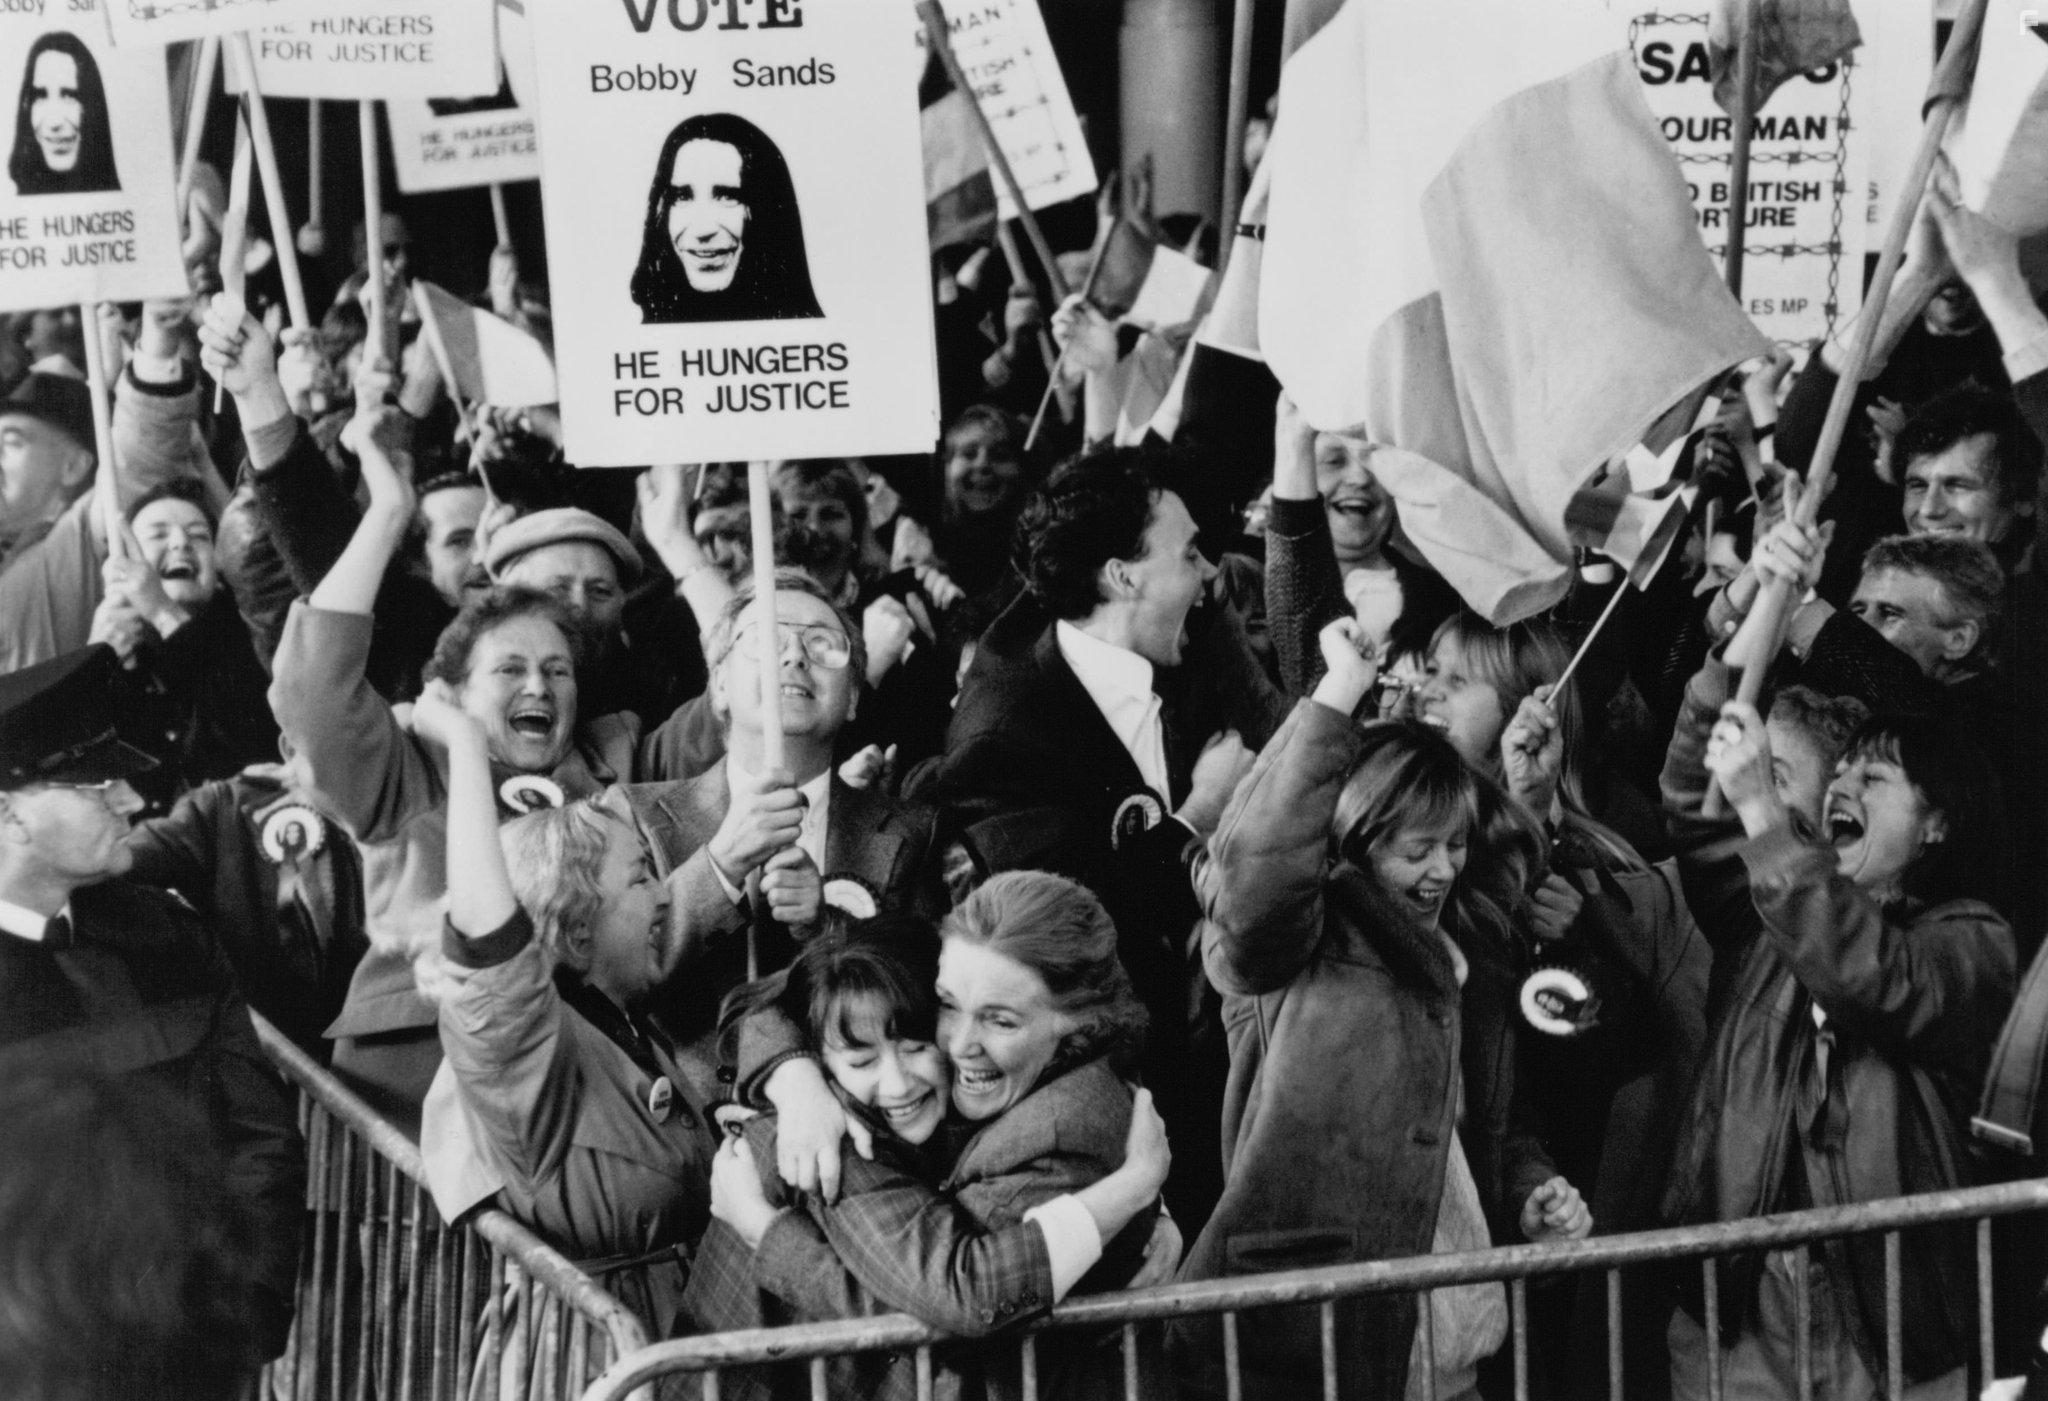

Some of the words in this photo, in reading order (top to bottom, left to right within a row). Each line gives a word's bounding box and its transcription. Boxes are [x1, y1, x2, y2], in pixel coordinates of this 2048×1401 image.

[310, 14, 434, 36] HUNGERS
[622, 0, 804, 33] VOTE
[261, 39, 312, 61] FOR
[328, 41, 434, 63] JUSTICE
[591, 62, 697, 96] Bobby
[732, 56, 836, 88] Sands
[1659, 115, 1732, 142] OUR
[1750, 115, 1828, 141] MAN
[1710, 181, 1821, 203] BITISH
[0, 217, 29, 239] HE
[42, 209, 135, 238] HUNGERS
[0, 246, 47, 269] FOR
[61, 239, 136, 267] JUSTICE
[1780, 298, 1809, 315] MP
[614, 351, 660, 380] HE
[681, 342, 849, 378] HUNGERS
[614, 387, 684, 417] FOR
[706, 380, 850, 414] JUSTICE
